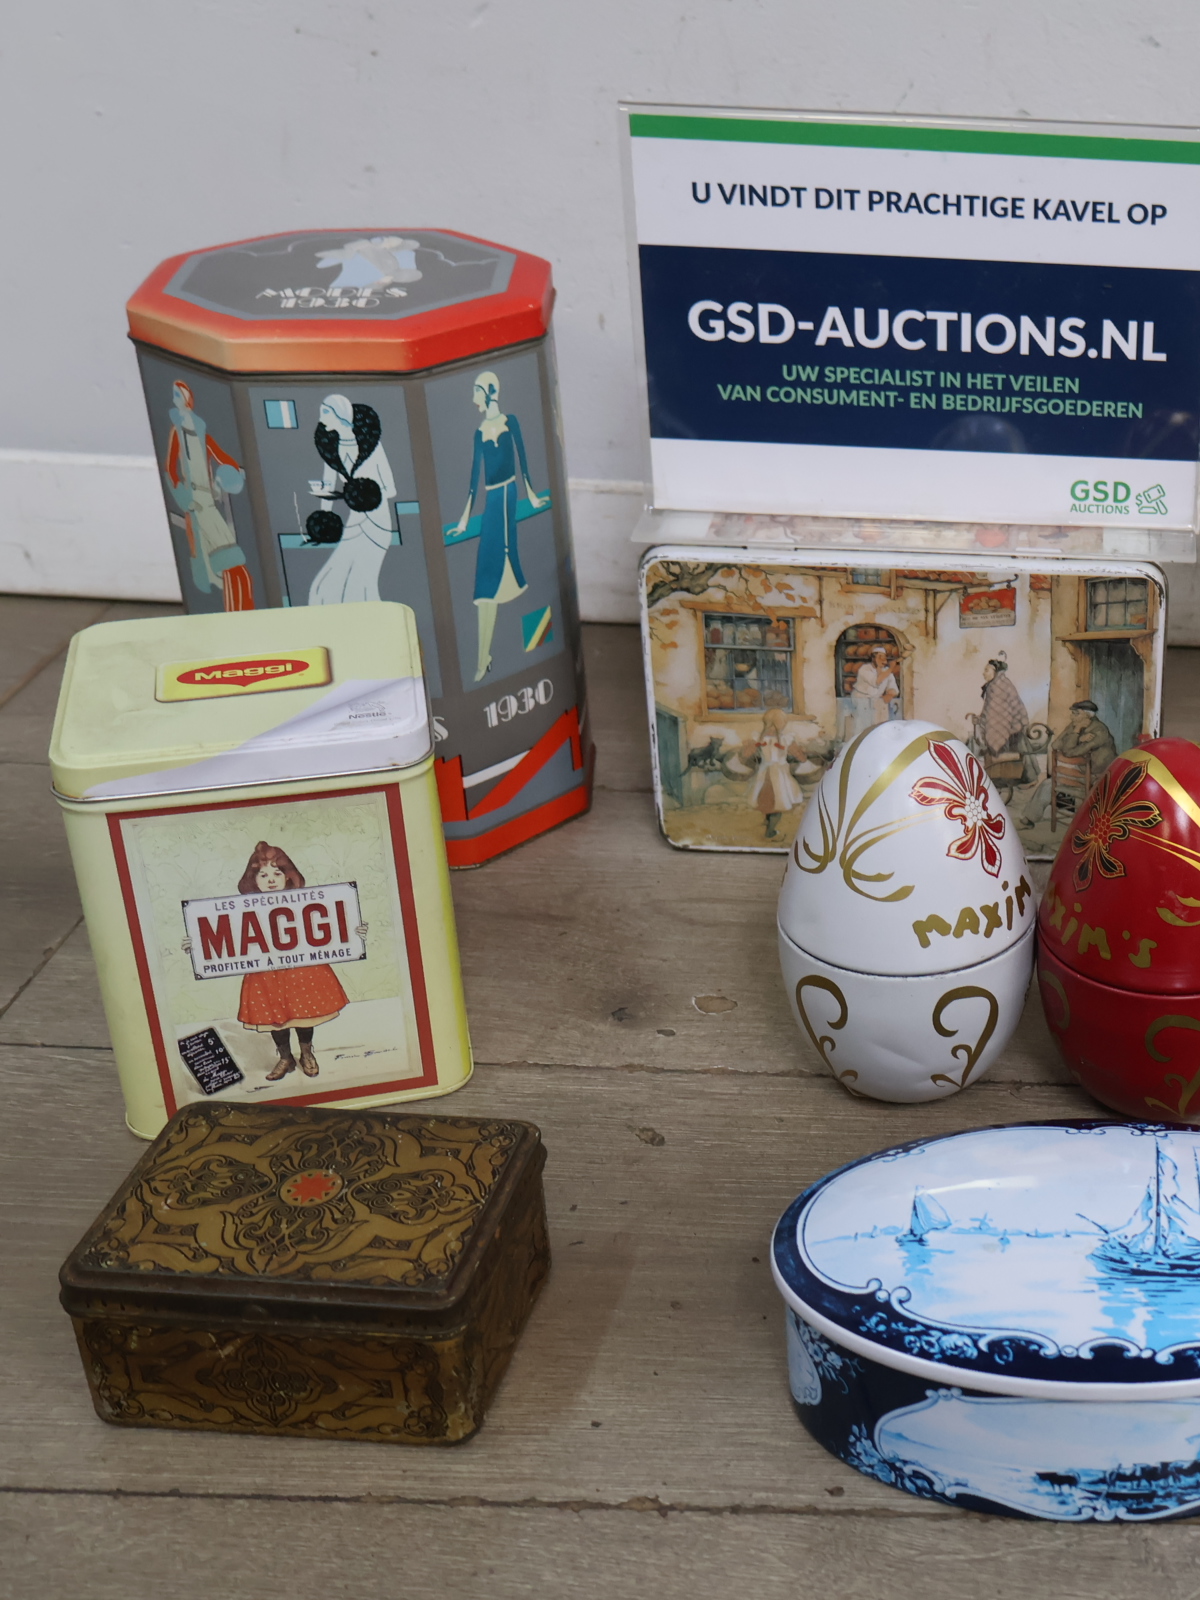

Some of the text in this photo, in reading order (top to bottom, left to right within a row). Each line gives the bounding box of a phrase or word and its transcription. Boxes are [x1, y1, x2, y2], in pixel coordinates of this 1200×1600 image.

[692, 182, 1167, 225] U VINDT DIT PRACHTIGE KAVEL OP
[688, 300, 1167, 361] GSD-AUCTIONS.NL
[782, 364, 1079, 394] UW SPECIALIST IN HET VEILEN
[717, 384, 1143, 419] VAN CONSUMENT- EN BEDRIJFSGOEDEREN
[1070, 480, 1131, 503] GSD
[1070, 503, 1130, 515] AUCTIONS
[194, 662, 294, 681] Maggi
[483, 678, 554, 728] 1930
[214, 890, 325, 912] LES SPÉCIALITÉS
[197, 900, 349, 961] MAGGI
[203, 958, 261, 974] PROFITENT
[266, 956, 275, 966] À
[278, 953, 306, 965] TOUT
[310, 948, 352, 962] MÉNAGE
